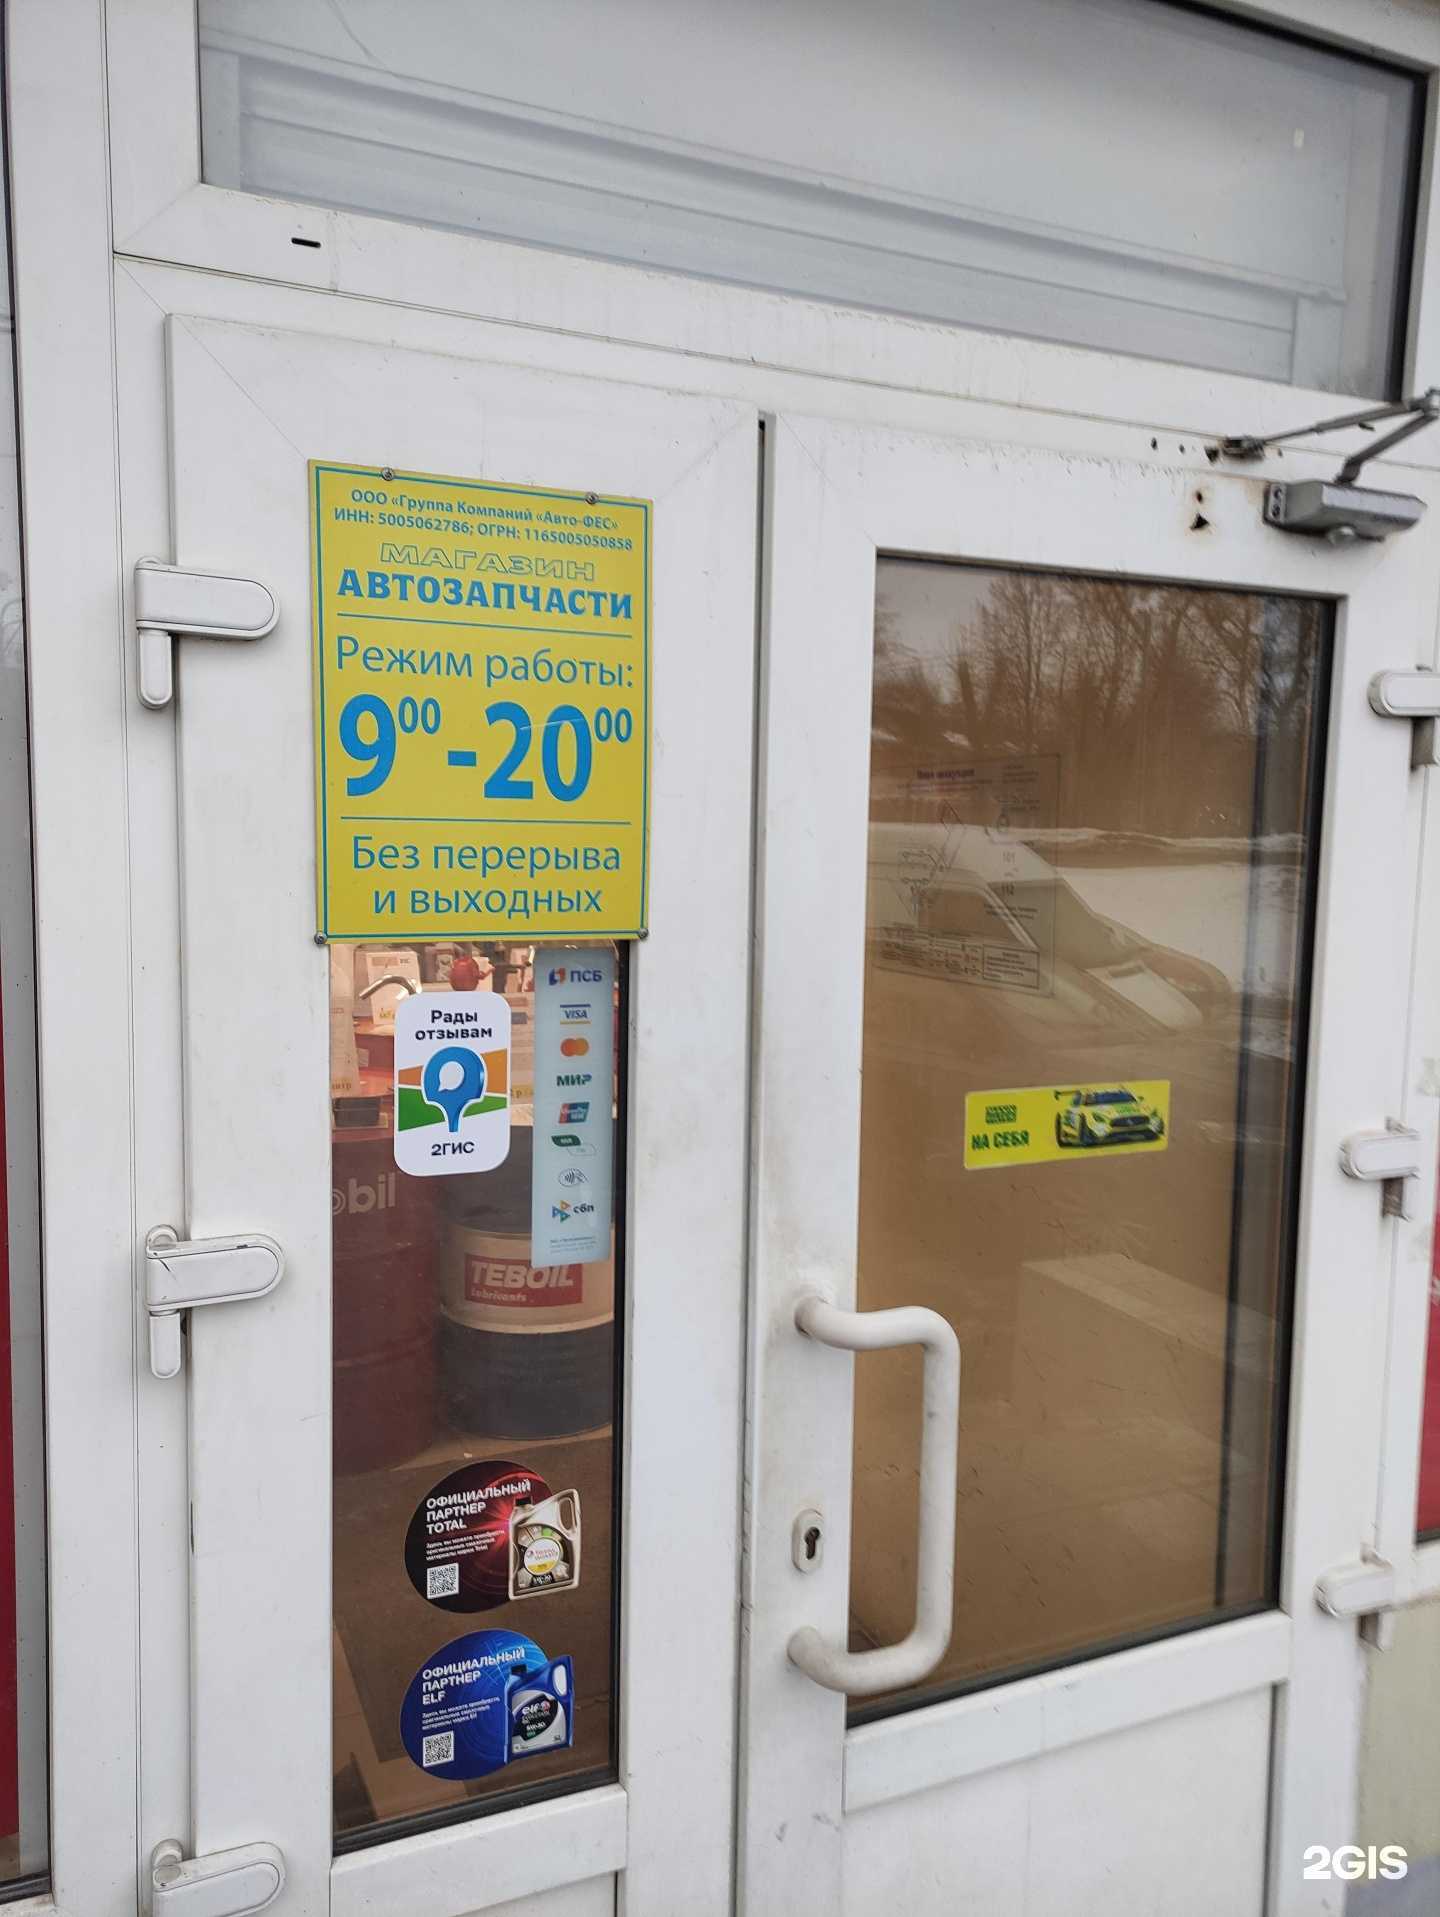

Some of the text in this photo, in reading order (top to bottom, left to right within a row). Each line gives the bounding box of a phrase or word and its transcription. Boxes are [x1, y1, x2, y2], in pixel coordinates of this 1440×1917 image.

[351, 490, 619, 531] ООО «Группа Компаний «Авто-ФЕС»
[334, 507, 633, 550] ИНН: 5005062786; ОГРН: 1165005050858
[379, 542, 596, 581] МАГАЗИН
[337, 568, 633, 619] АВТОЗАПЧАСТИ
[336, 635, 634, 688] Режим работы:
[353, 835, 621, 878] Без перерыва
[373, 889, 603, 919] и выходных
[569, 969, 603, 983] ПСБ
[430, 1009, 478, 1025] Рады
[564, 1009, 588, 1019] VISA
[414, 1027, 493, 1041] отзывам
[556, 1072, 593, 1087] МИР
[430, 1141, 475, 1156] 2ГИС
[331, 1171, 396, 1216] obil
[470, 1260, 575, 1289] TEBOIL
[426, 1478, 532, 1510] ОФИЦИАЛЬНЫЙ
[426, 1501, 487, 1523] ПАРТНЕР
[426, 1518, 468, 1535] TOTAL
[422, 1647, 525, 1680] ОФИЦИАЛЬНЫЙ
[422, 1671, 481, 1693] ПАРТНЕР
[422, 1690, 446, 1706] ELF
